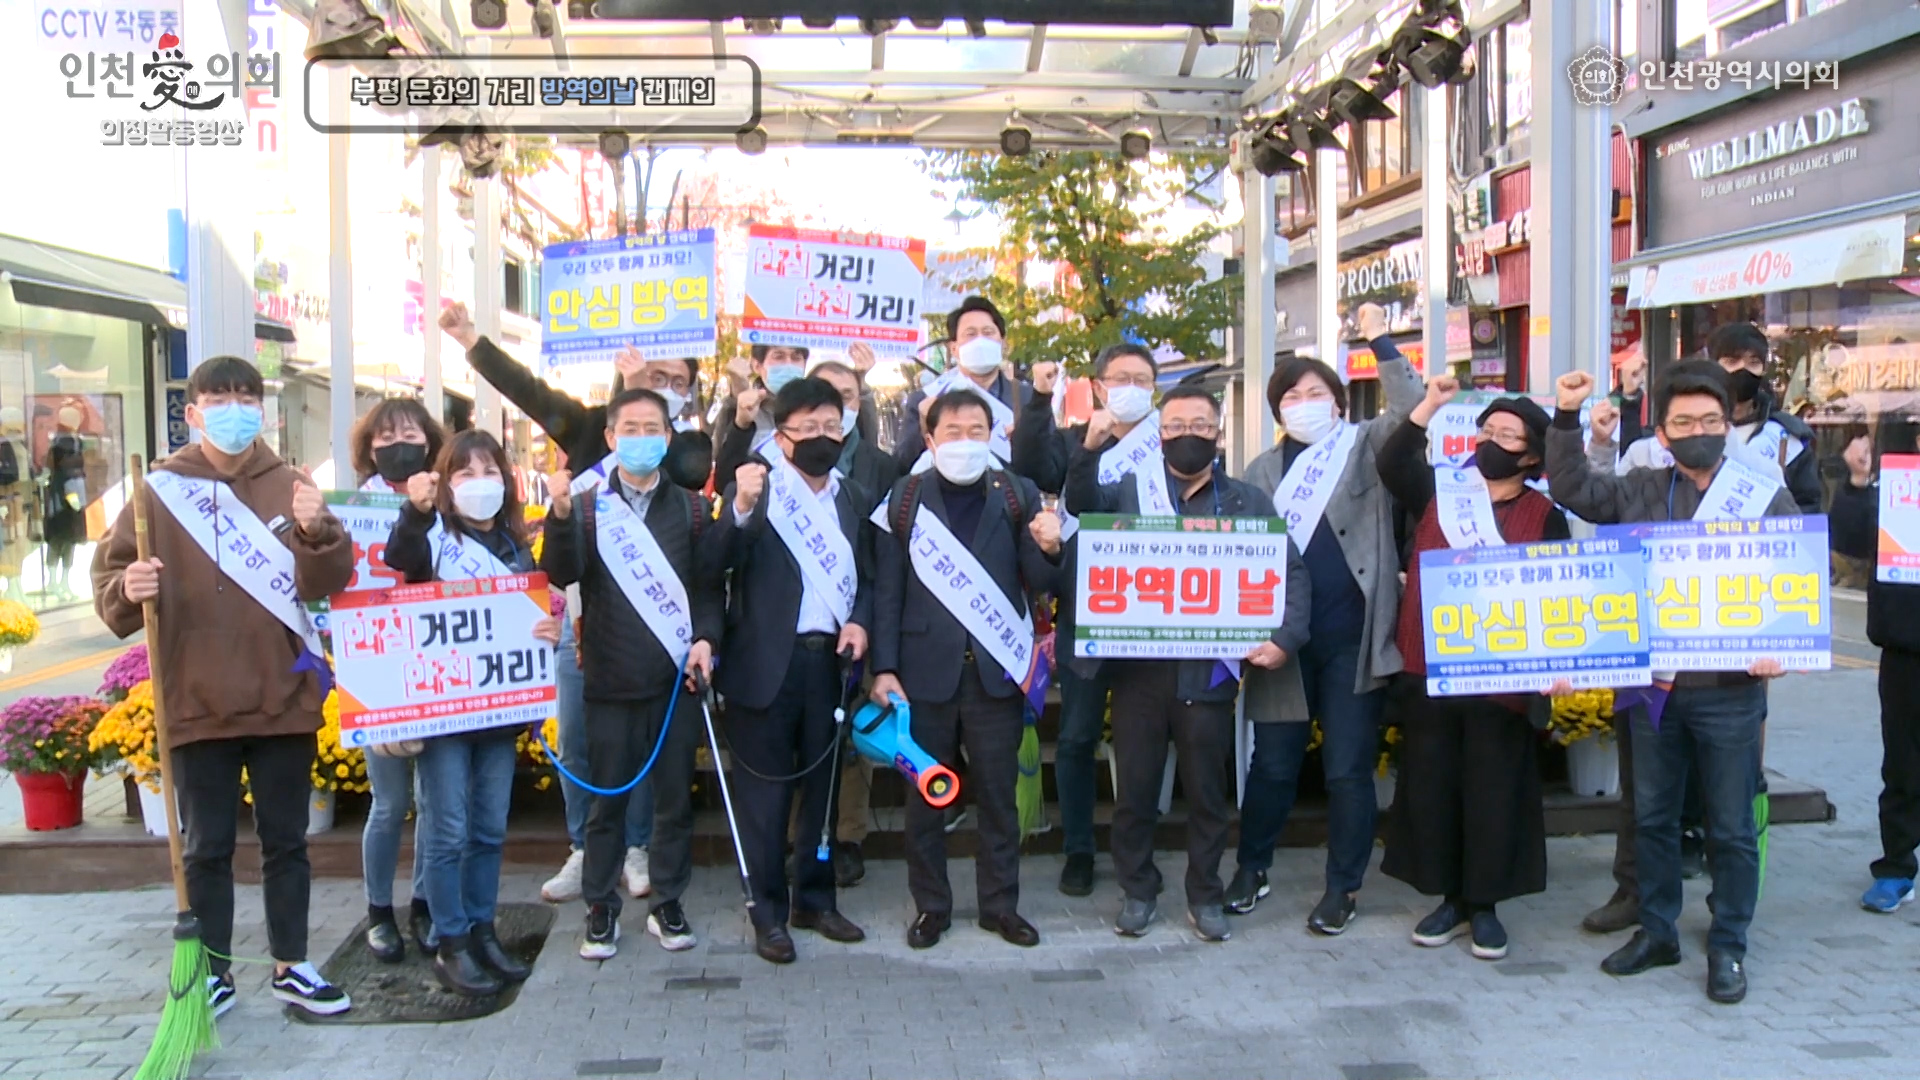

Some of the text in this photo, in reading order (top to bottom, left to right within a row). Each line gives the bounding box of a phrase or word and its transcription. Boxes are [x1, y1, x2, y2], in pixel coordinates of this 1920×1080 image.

[41, 9, 178, 43] CCTV 작동중
[1687, 98, 1869, 180] WELLMADE
[1701, 185, 1716, 199] FOR
[1717, 181, 1733, 195] OUR
[1735, 175, 1757, 192] WORK
[1769, 164, 1786, 181] LIFE
[1789, 152, 1829, 176] BALANCE
[1832, 147, 1857, 165] WITH
[1751, 186, 1795, 206] INDIAN
[562, 251, 692, 276] 우리 모두 함께 지켜요!
[814, 252, 874, 285] 거리!
[1743, 250, 1792, 286] 40%
[548, 275, 709, 333] 안심 방역
[855, 293, 915, 325] 거리!
[1658, 544, 1692, 562] 모두
[1696, 542, 1731, 561] 함께
[1736, 541, 1797, 560] 지켜요!
[1088, 565, 1281, 616] 방역의 날
[1447, 561, 1614, 588] 우리 모두 함께 지켜요!
[1646, 572, 1821, 629] 심 방역
[419, 607, 493, 648] 거리!
[1432, 592, 1640, 655] 안심 방역
[477, 647, 548, 688] 거리!
